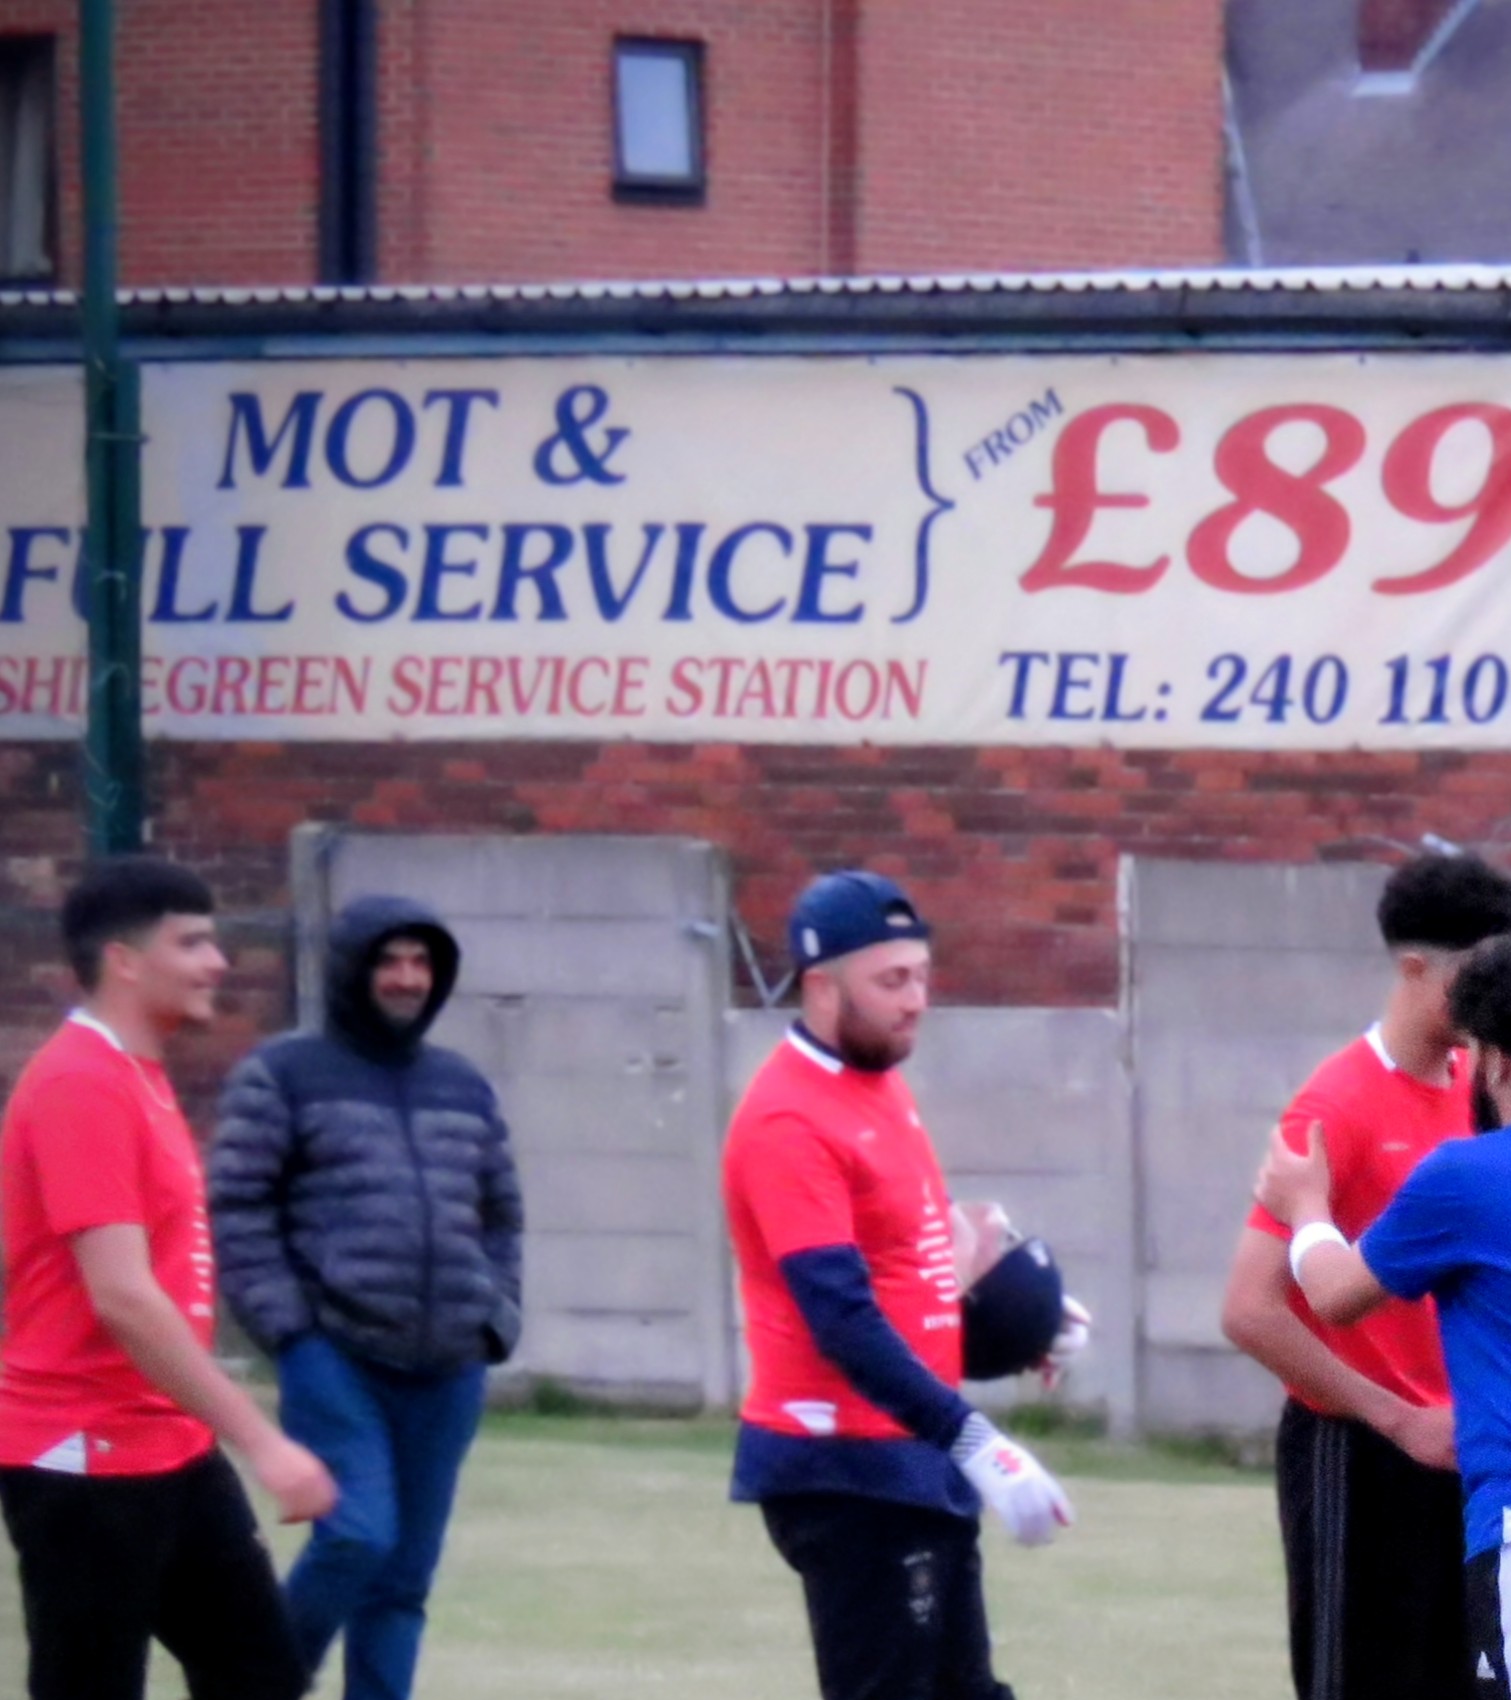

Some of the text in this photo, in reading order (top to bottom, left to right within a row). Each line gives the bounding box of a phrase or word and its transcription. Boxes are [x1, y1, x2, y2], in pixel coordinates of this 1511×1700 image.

[215, 384, 632, 490] MOT &
[963, 386, 1064, 481] FROM
[334, 521, 873, 624] SERVICE
[0, 655, 928, 721] SHIEGREEN SERVICE STATION
[1000, 651, 1173, 722] TEL:
[1200, 653, 1348, 725] 240
